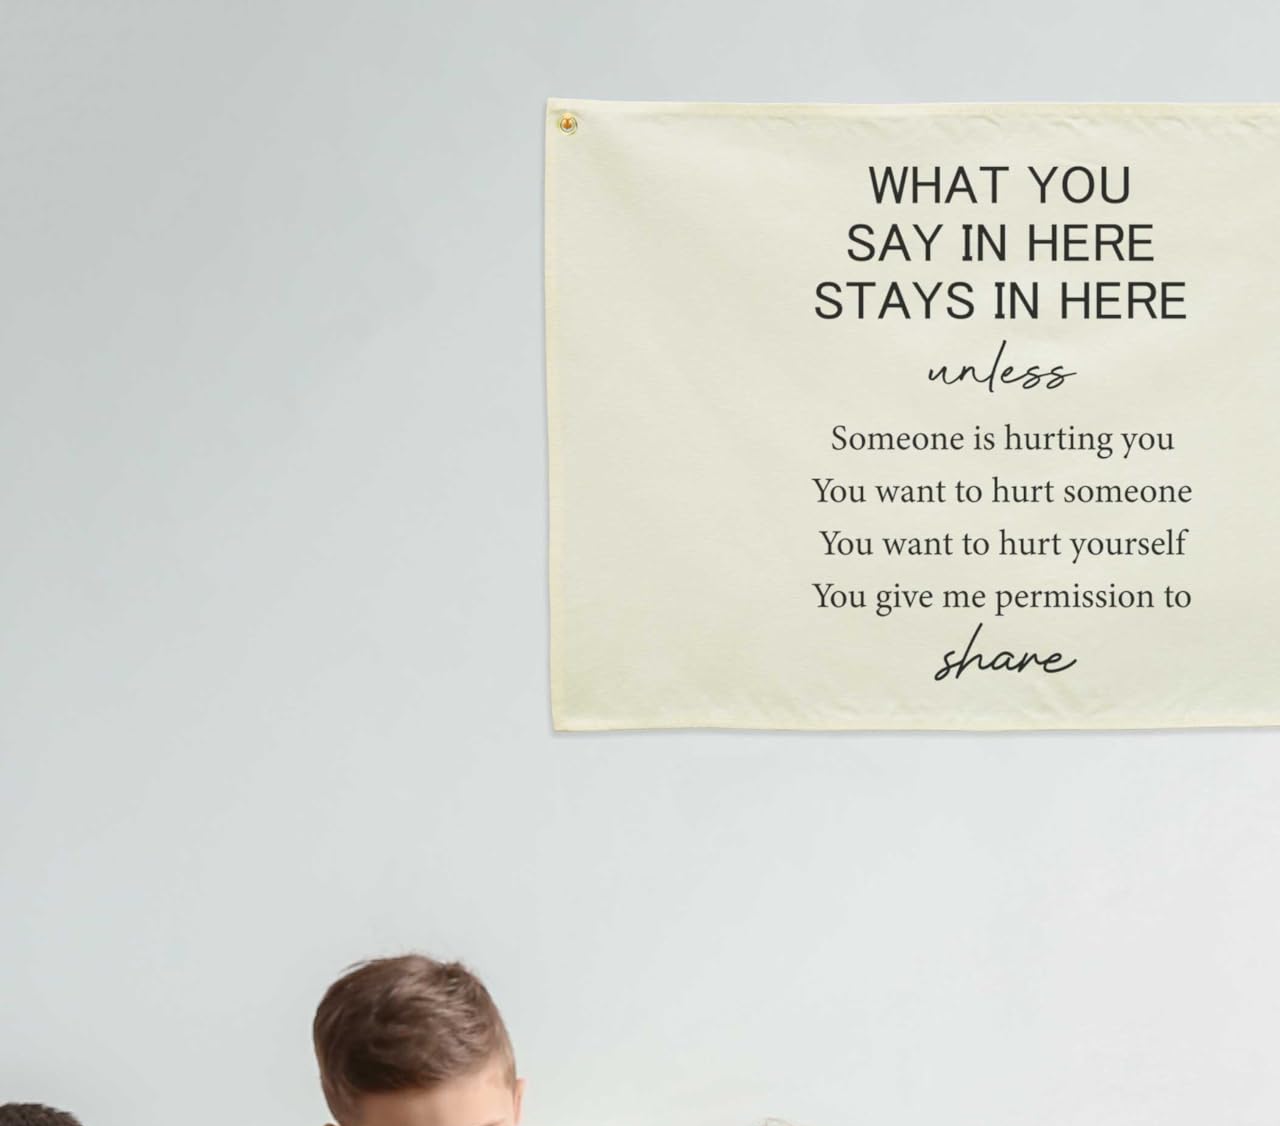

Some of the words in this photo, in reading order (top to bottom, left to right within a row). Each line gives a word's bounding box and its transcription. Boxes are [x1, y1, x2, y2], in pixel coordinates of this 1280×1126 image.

[868, 165, 1010, 205] WHAT
[1027, 165, 1130, 204] YOU
[847, 223, 944, 262] SAY
[961, 223, 1006, 262] IN
[1028, 223, 1155, 262] HERE
[814, 281, 975, 320] STAYS
[994, 281, 1039, 320] IN
[1061, 281, 1187, 320] HERE
[928, 339, 1077, 393] unless
[831, 425, 964, 451] Someone
[973, 425, 995, 451] is
[1004, 423, 1113, 460] hurting
[1120, 432, 1175, 459] you
[811, 478, 867, 503] You
[875, 480, 946, 503] want
[954, 480, 983, 503] to
[991, 476, 1054, 503] hurt
[1063, 485, 1193, 503] someone
[819, 530, 873, 556] You
[882, 533, 953, 556] want
[962, 533, 990, 556] to
[999, 528, 1062, 556] hurt
[1069, 528, 1190, 565] yourself
[811, 583, 867, 608] You
[875, 583, 933, 617] give
[942, 590, 986, 608] me
[995, 583, 1155, 617] permission
[1164, 585, 1192, 608] to
[934, 622, 1078, 682] share
